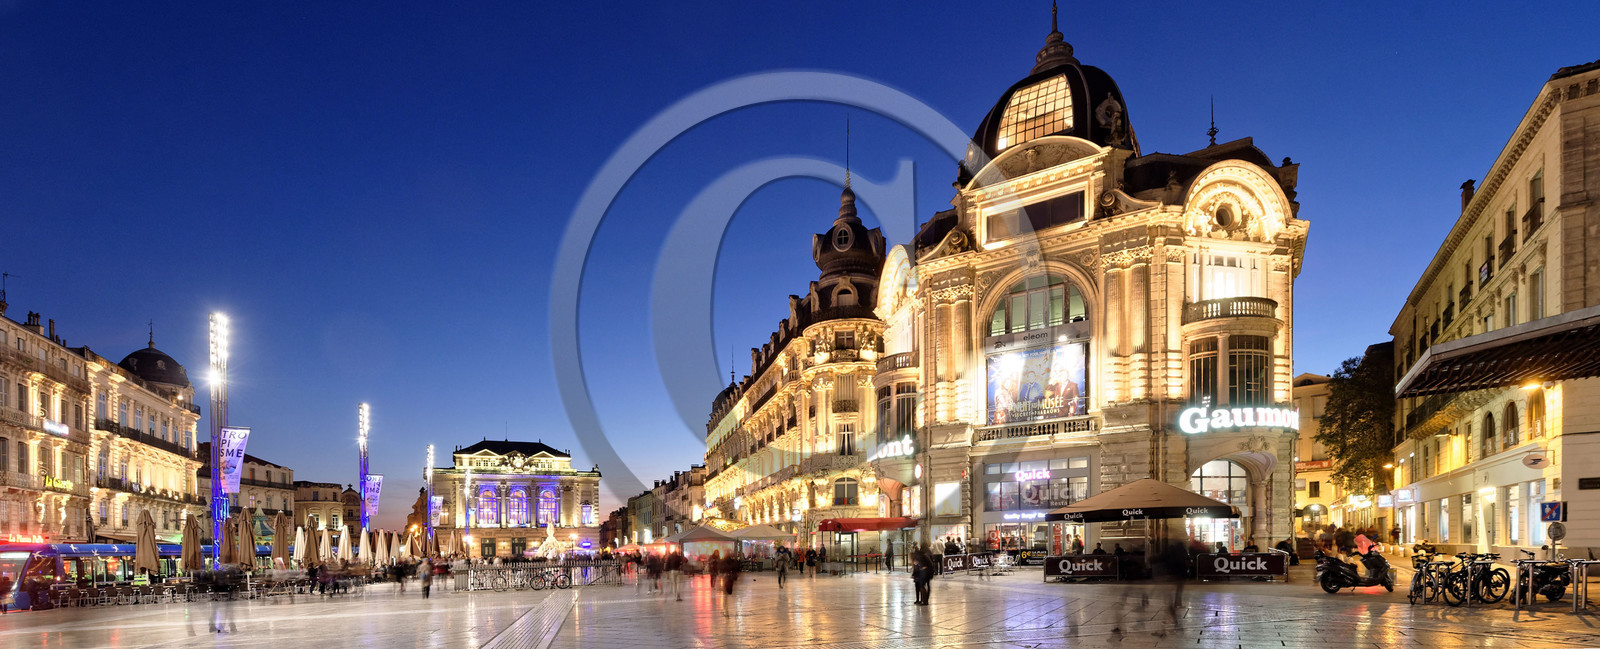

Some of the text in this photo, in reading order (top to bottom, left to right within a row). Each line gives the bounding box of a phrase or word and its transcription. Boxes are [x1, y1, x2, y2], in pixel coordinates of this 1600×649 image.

[1023, 333, 1048, 341] eleom
[1038, 395, 1064, 410] MUSÉE
[222, 430, 247, 439] TRO
[221, 439, 231, 448] PI
[220, 448, 244, 458] SME
[1015, 470, 1052, 482] Quick
[1064, 513, 1084, 521] Quick
[948, 558, 964, 571] Quick
[973, 555, 989, 568] Quick
[1058, 559, 1104, 575] Quick
[1214, 556, 1268, 574] Quick
